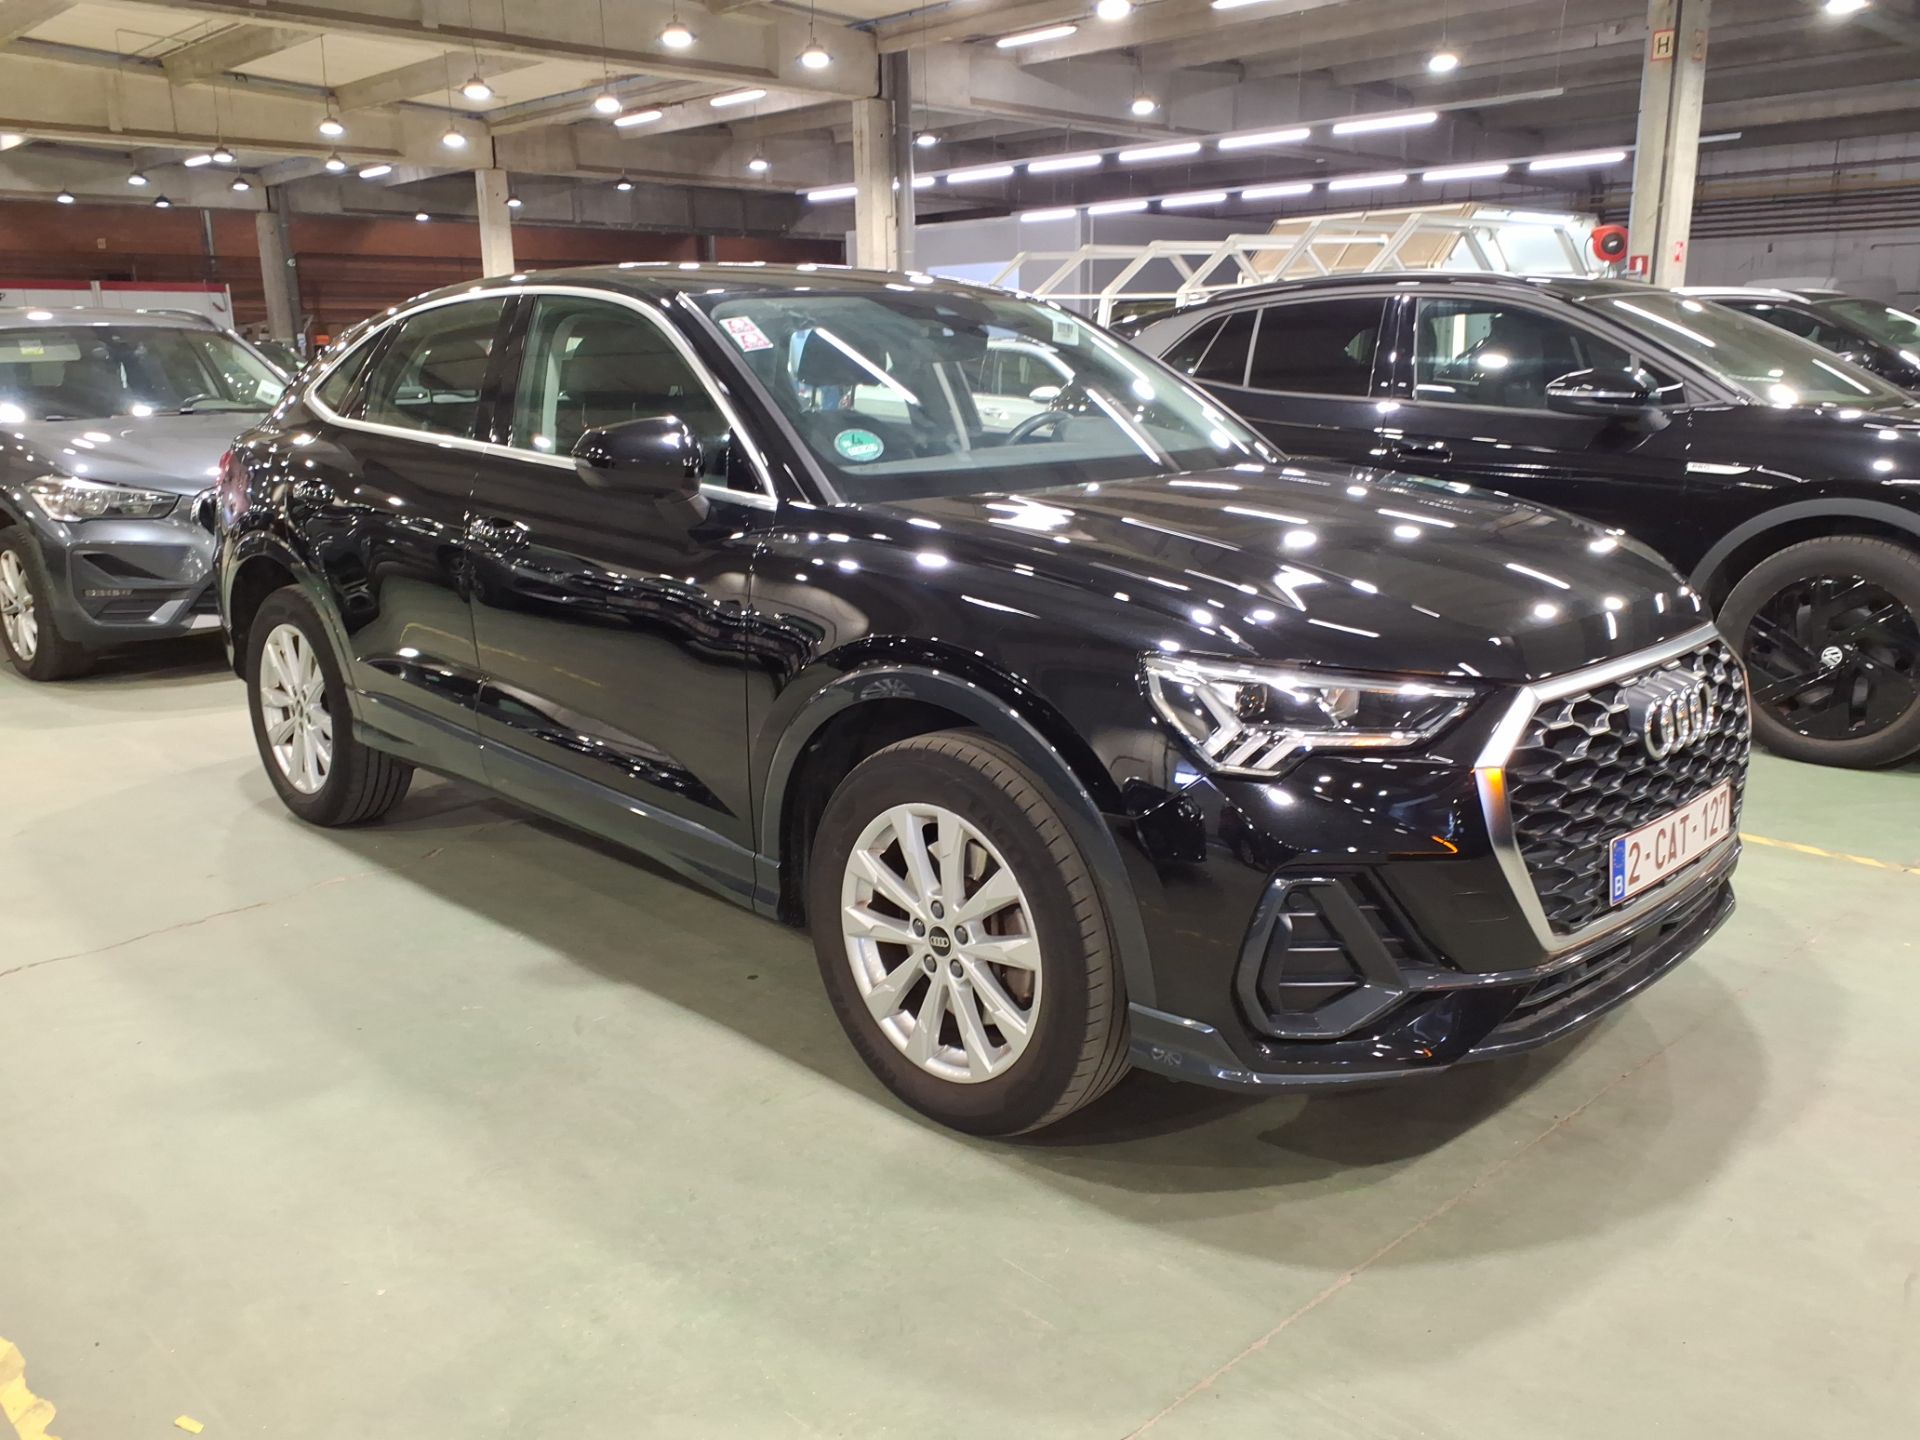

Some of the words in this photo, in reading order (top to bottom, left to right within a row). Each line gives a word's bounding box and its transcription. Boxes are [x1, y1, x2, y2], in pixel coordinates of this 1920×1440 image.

[1657, 36, 1670, 54] H
[1627, 789, 1729, 886] 2-CAT-127
[1614, 875, 1624, 897] B
